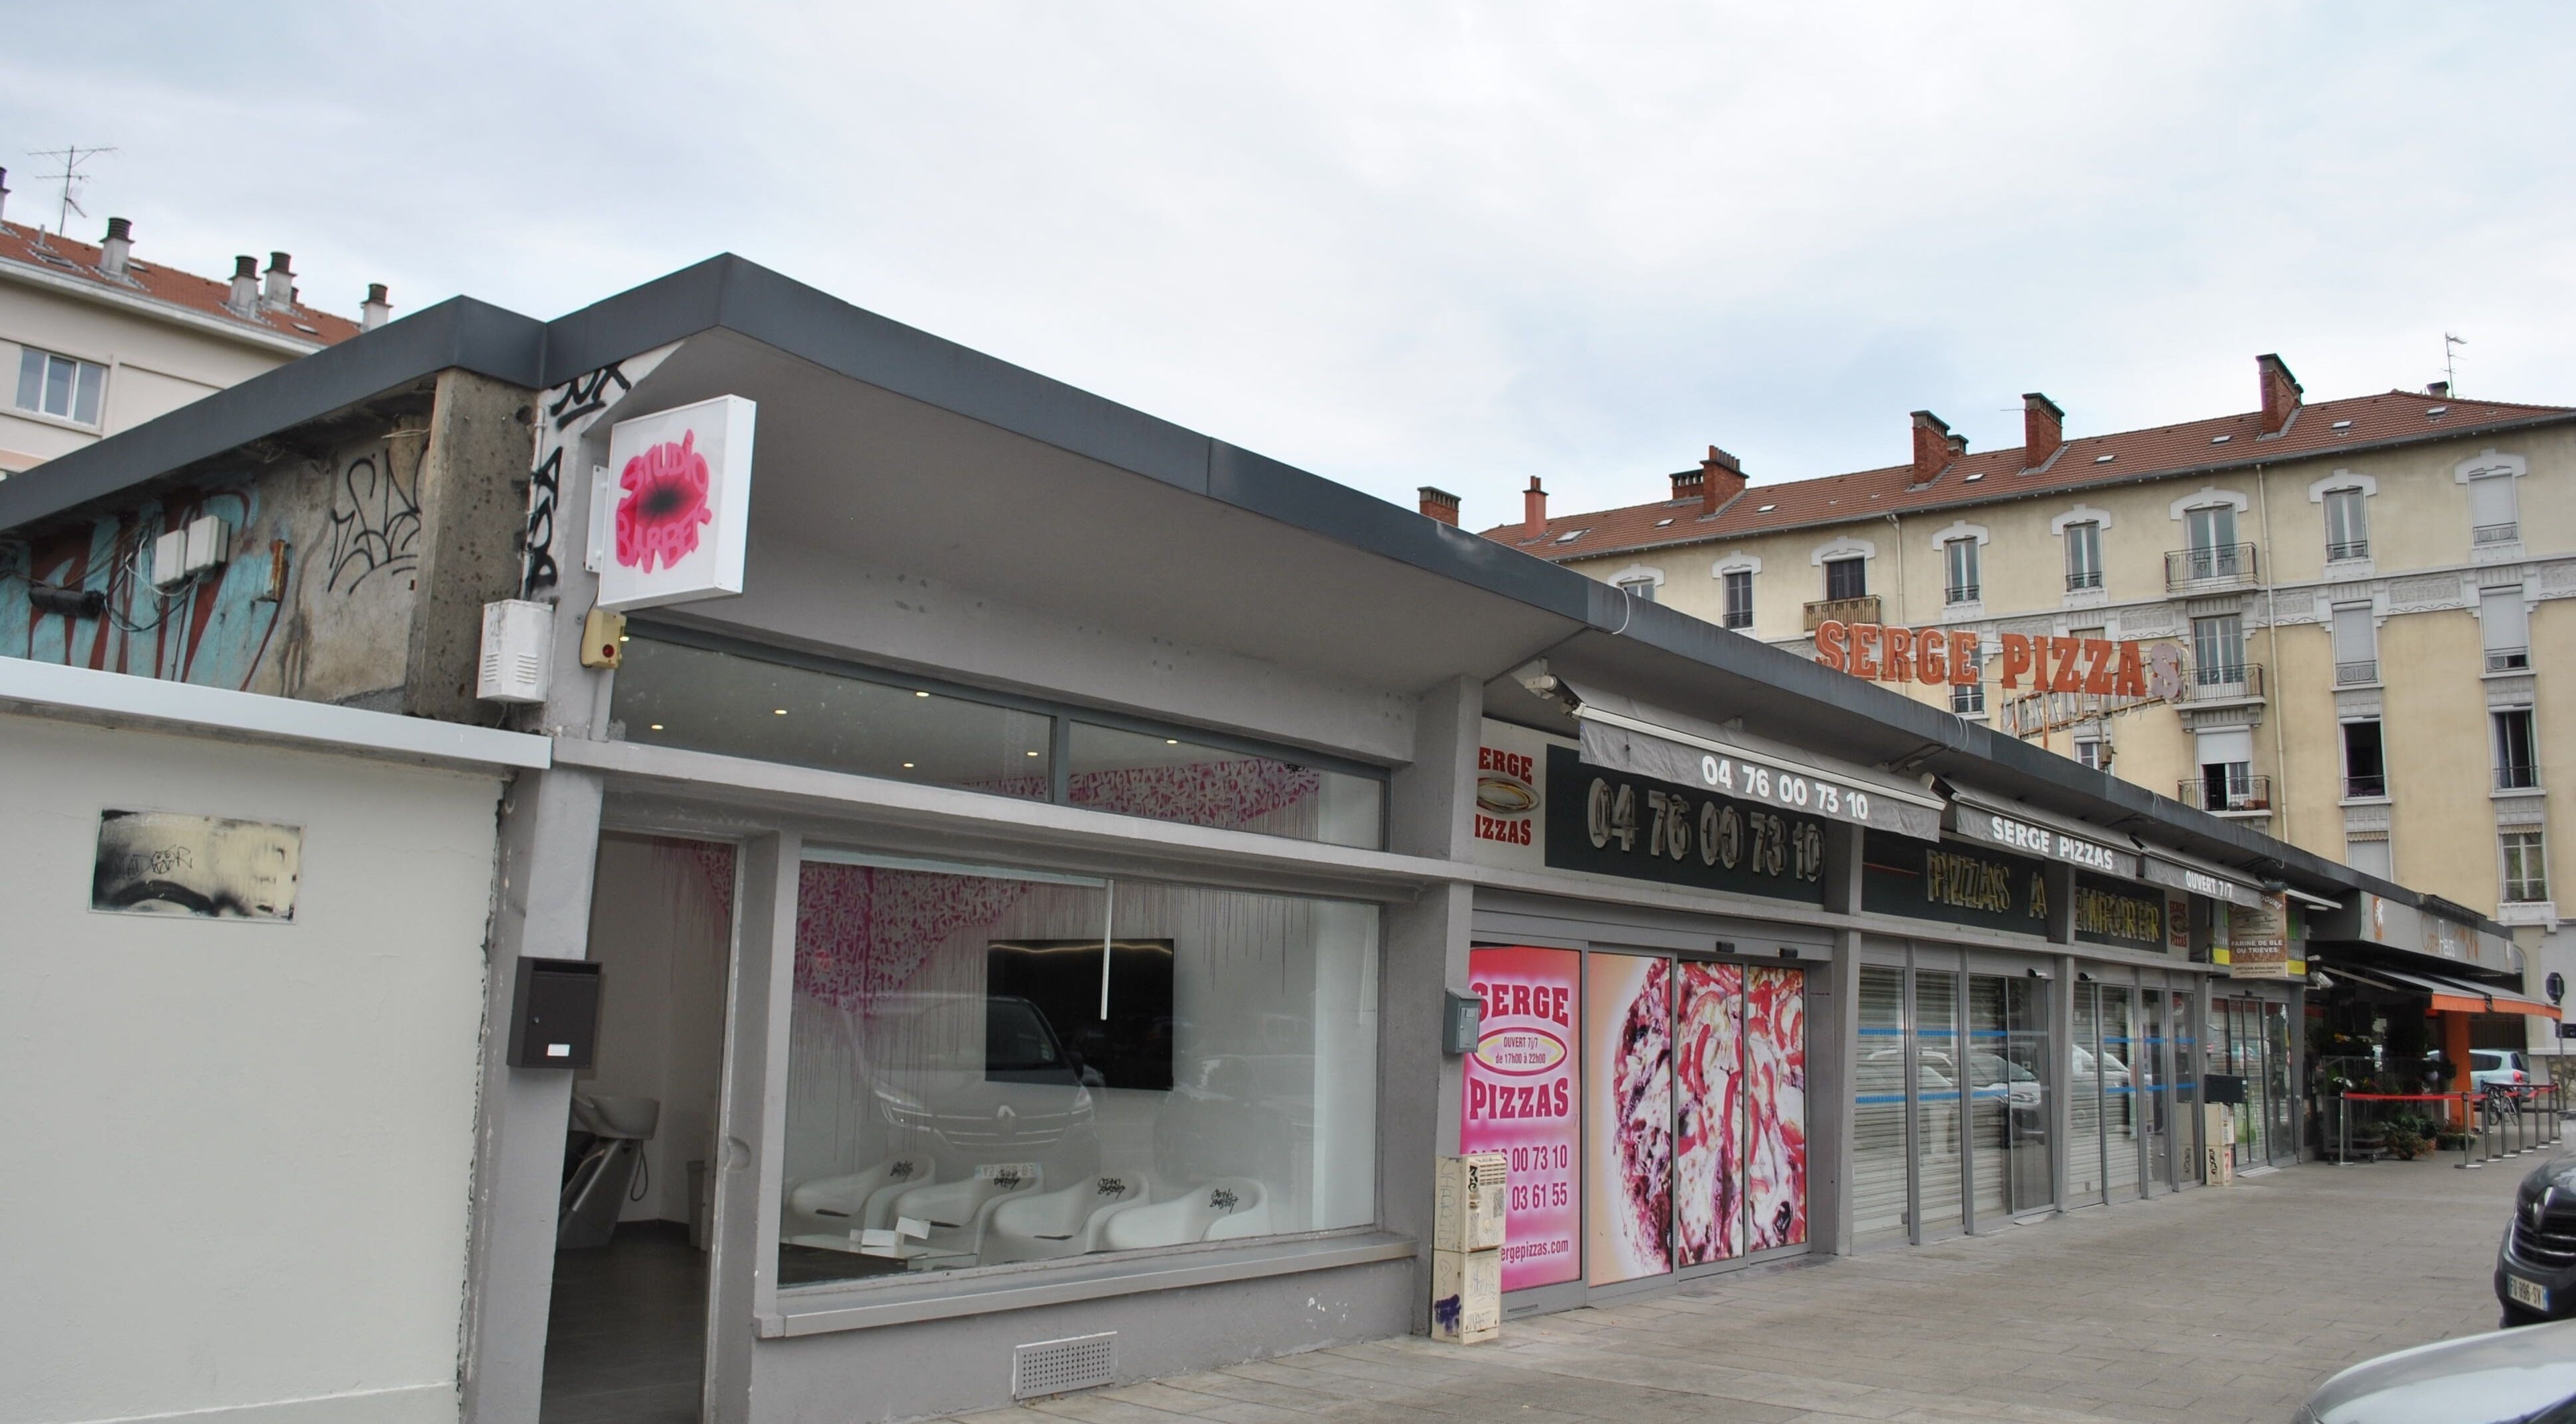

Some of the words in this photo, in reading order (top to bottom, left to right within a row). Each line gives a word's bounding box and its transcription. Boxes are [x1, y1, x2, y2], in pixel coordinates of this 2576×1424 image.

[618, 429, 710, 510] STUDIO
[1815, 620, 1978, 686] SERGE
[2001, 633, 2184, 702] PIZZAS
[1479, 747, 1532, 785] ERGE
[1702, 755, 1732, 789] 04
[1742, 765, 1770, 797] 76
[1779, 775, 1807, 806] 00
[1815, 782, 1839, 813] 73
[1846, 791, 1868, 820] 10
[1474, 814, 1531, 846] IZZAS
[1588, 777, 1638, 851] 04
[1648, 790, 1692, 861] 76
[1700, 801, 1743, 869] 00
[1750, 811, 1787, 876] 73
[1793, 821, 1825, 882] 10
[1992, 816, 2050, 853] SERGE
[2059, 836, 2113, 870] PIZZAS
[1926, 848, 2010, 914] PIZZAS
[2185, 870, 2216, 894] OUVERT
[2218, 879, 2233, 898] 7/7
[1471, 982, 1568, 1028] SERGE
[1495, 1054, 1503, 1064] de
[1505, 1054, 1522, 1064] 17h00
[1523, 1054, 1527, 1064] à
[1529, 1054, 1546, 1064] 22h00
[1503, 1037, 1526, 1048] OUVERT
[1470, 1077, 1568, 1119] PIZZAS
[1512, 1147, 1528, 1172] 00
[1532, 1146, 1548, 1170] 73
[1552, 1144, 1567, 1168] 10
[1512, 1185, 1528, 1211] 03
[1533, 1183, 1546, 1209] 61
[1552, 1182, 1567, 1206] 55
[1501, 1240, 1568, 1264] ergepizzas.com
